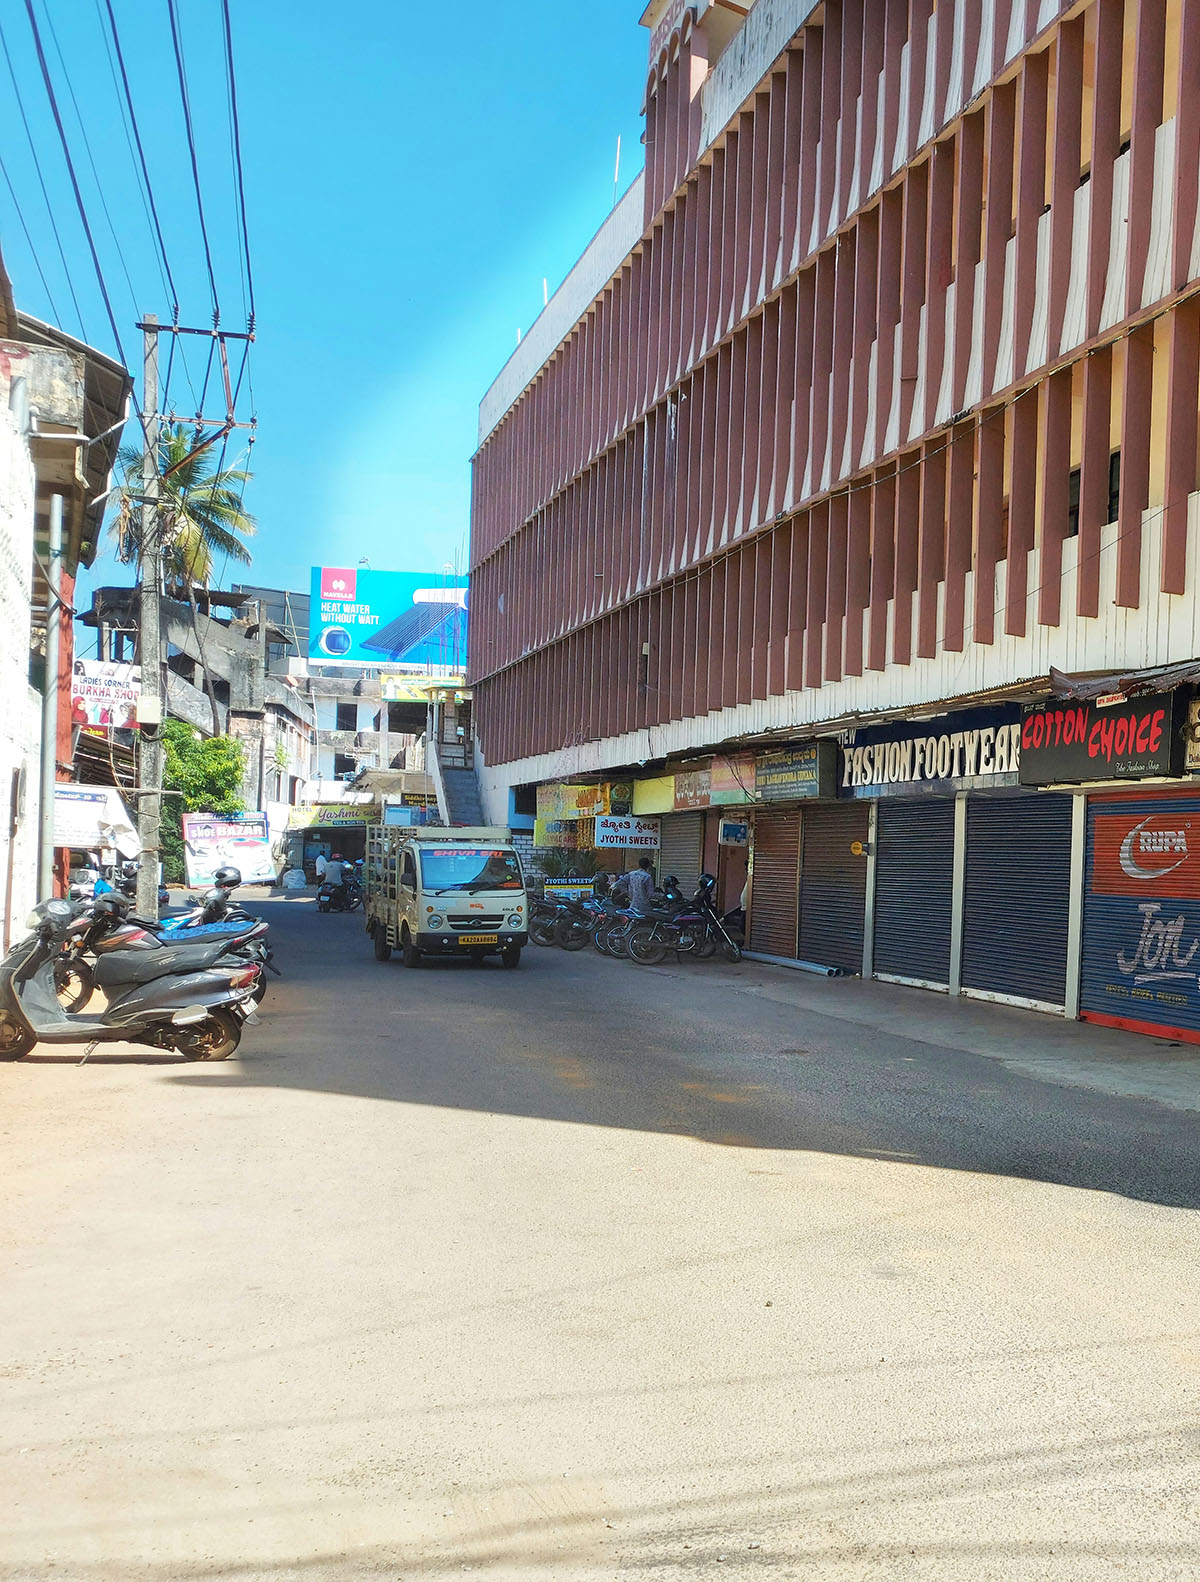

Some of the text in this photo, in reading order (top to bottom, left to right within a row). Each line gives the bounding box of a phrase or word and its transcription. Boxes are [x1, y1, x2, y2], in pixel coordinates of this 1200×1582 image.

[321, 602, 370, 614] HEAT WATER
[321, 613, 356, 624] WITHOUT
[103, 677, 131, 689] CORNER
[72, 683, 111, 698] BURKHA
[1022, 706, 1166, 763] COTTON CHOICE
[842, 723, 1022, 788] FASHION FOOTWEAR
[216, 825, 263, 837] BAZAR
[600, 835, 658, 845] JYOTHI SWEETS
[1139, 830, 1188, 853] RUPA
